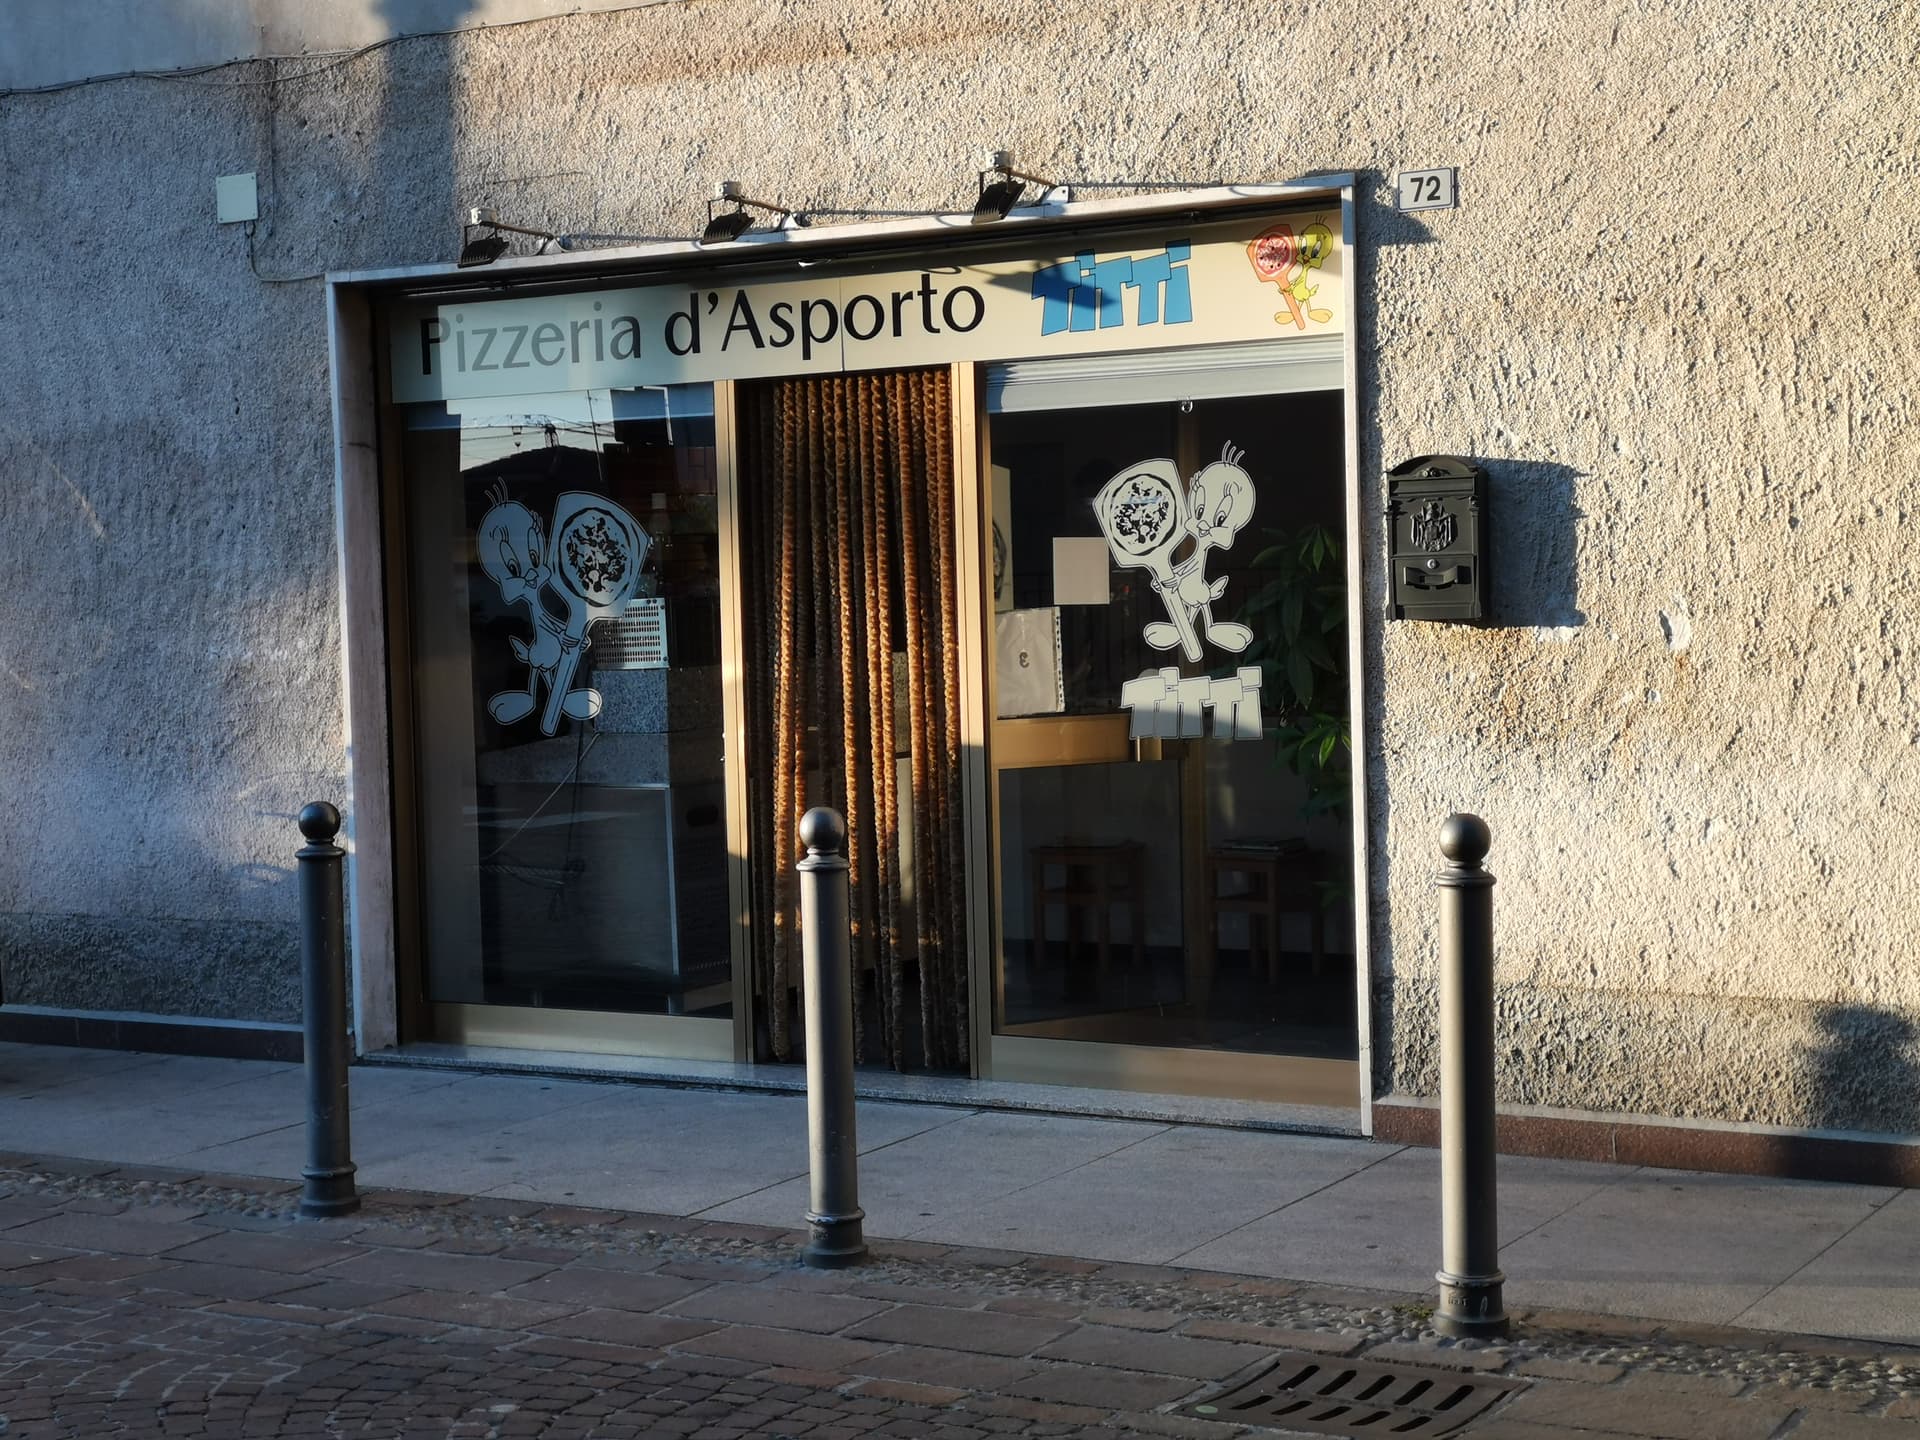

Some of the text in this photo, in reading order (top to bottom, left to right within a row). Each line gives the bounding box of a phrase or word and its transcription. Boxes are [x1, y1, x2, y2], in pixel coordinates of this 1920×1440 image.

[1410, 175, 1441, 202] 72
[420, 272, 986, 376] Pizzeria d'Asporto
